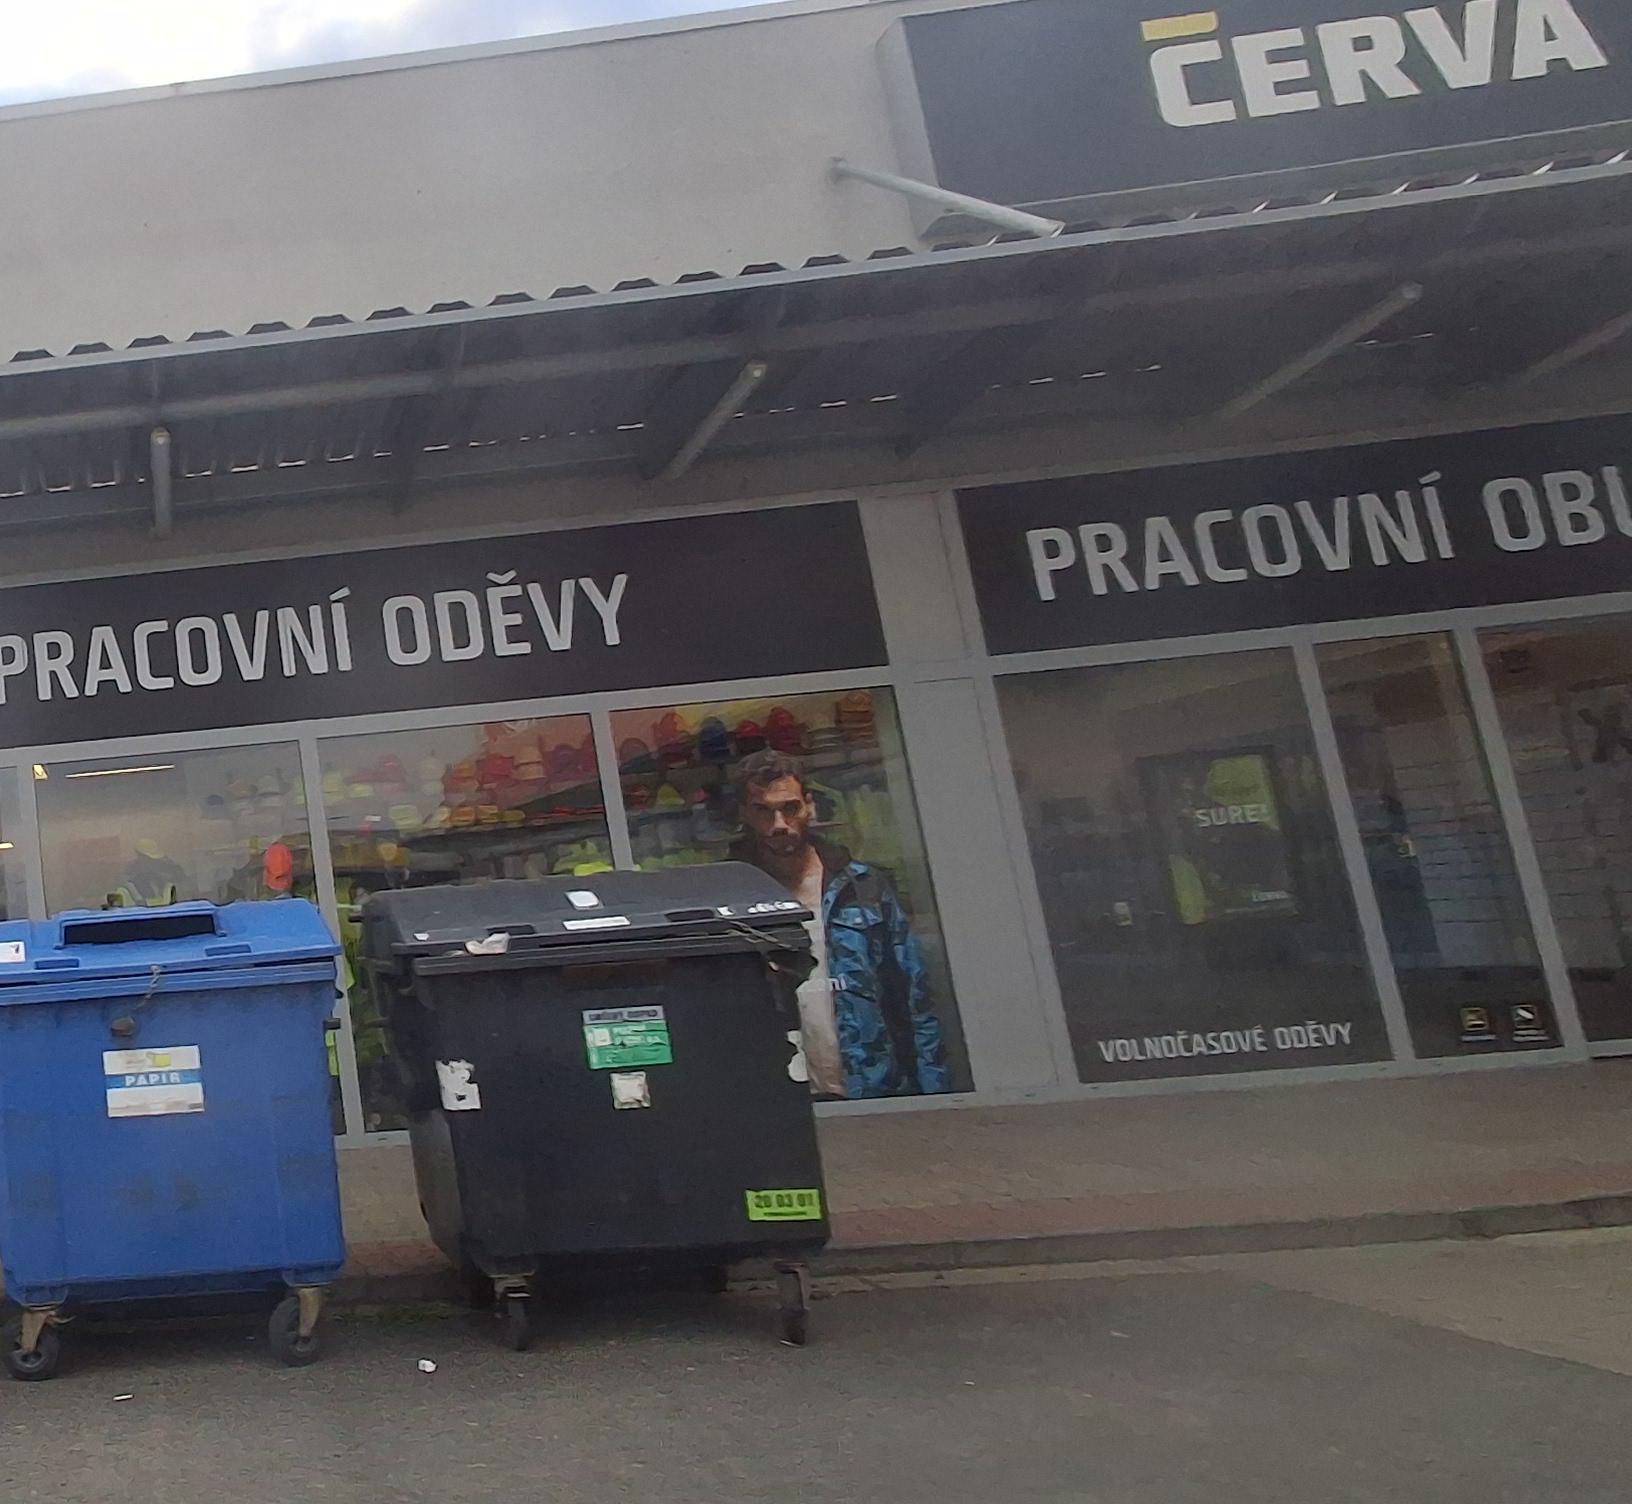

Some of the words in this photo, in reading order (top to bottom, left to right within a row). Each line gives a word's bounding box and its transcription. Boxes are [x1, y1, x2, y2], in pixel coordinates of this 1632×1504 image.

[1025, 470, 1455, 601] PRACOVNÍ
[381, 570, 628, 667] ODĚVY
[1097, 1024, 1268, 1063] VOLNOČASOVÉ
[1273, 1020, 1352, 1050] ODĚVY
